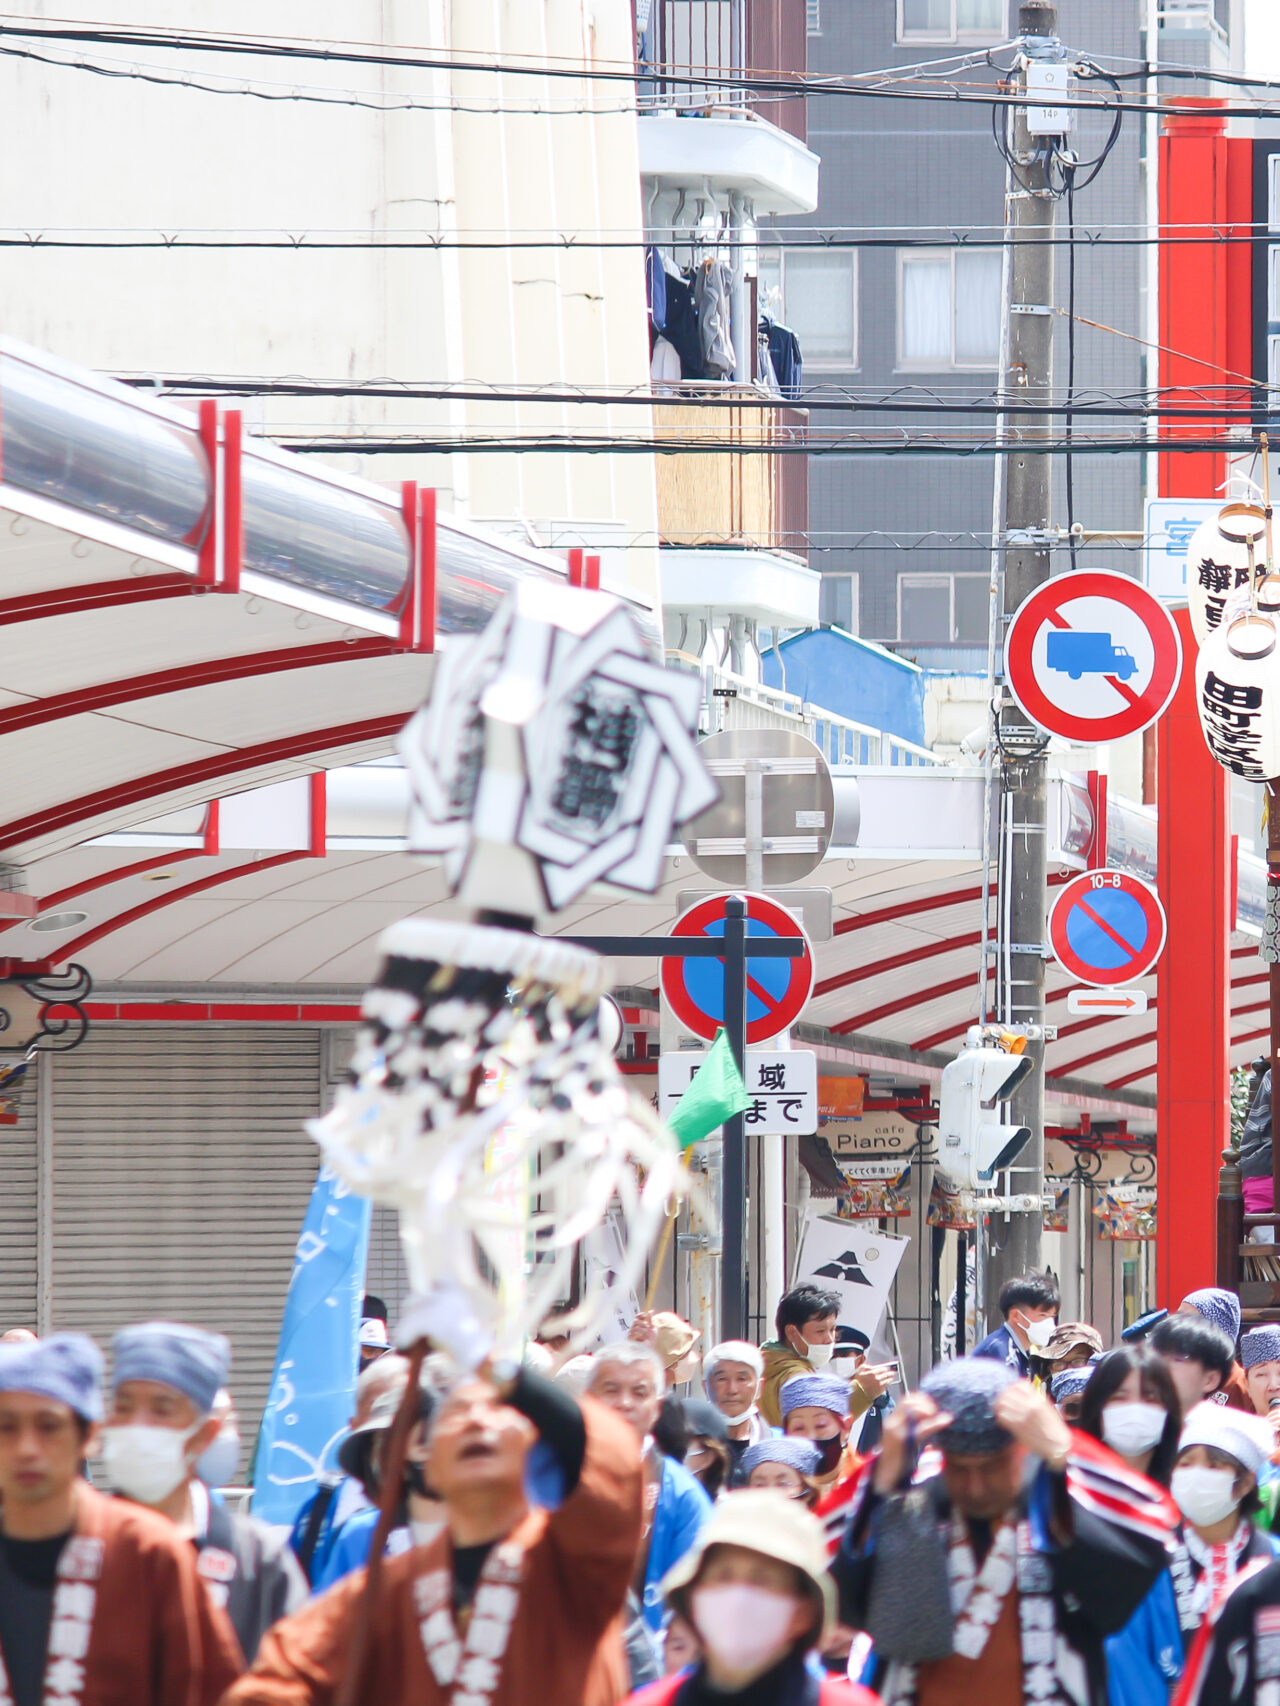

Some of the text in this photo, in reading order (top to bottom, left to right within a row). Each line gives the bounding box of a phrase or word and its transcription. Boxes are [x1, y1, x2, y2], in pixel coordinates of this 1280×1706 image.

[1203, 671, 1268, 783] 田町学区連
[1090, 874, 1122, 889] 10-8
[875, 1126, 905, 1134] cafe
[837, 1134, 901, 1150] Piano
